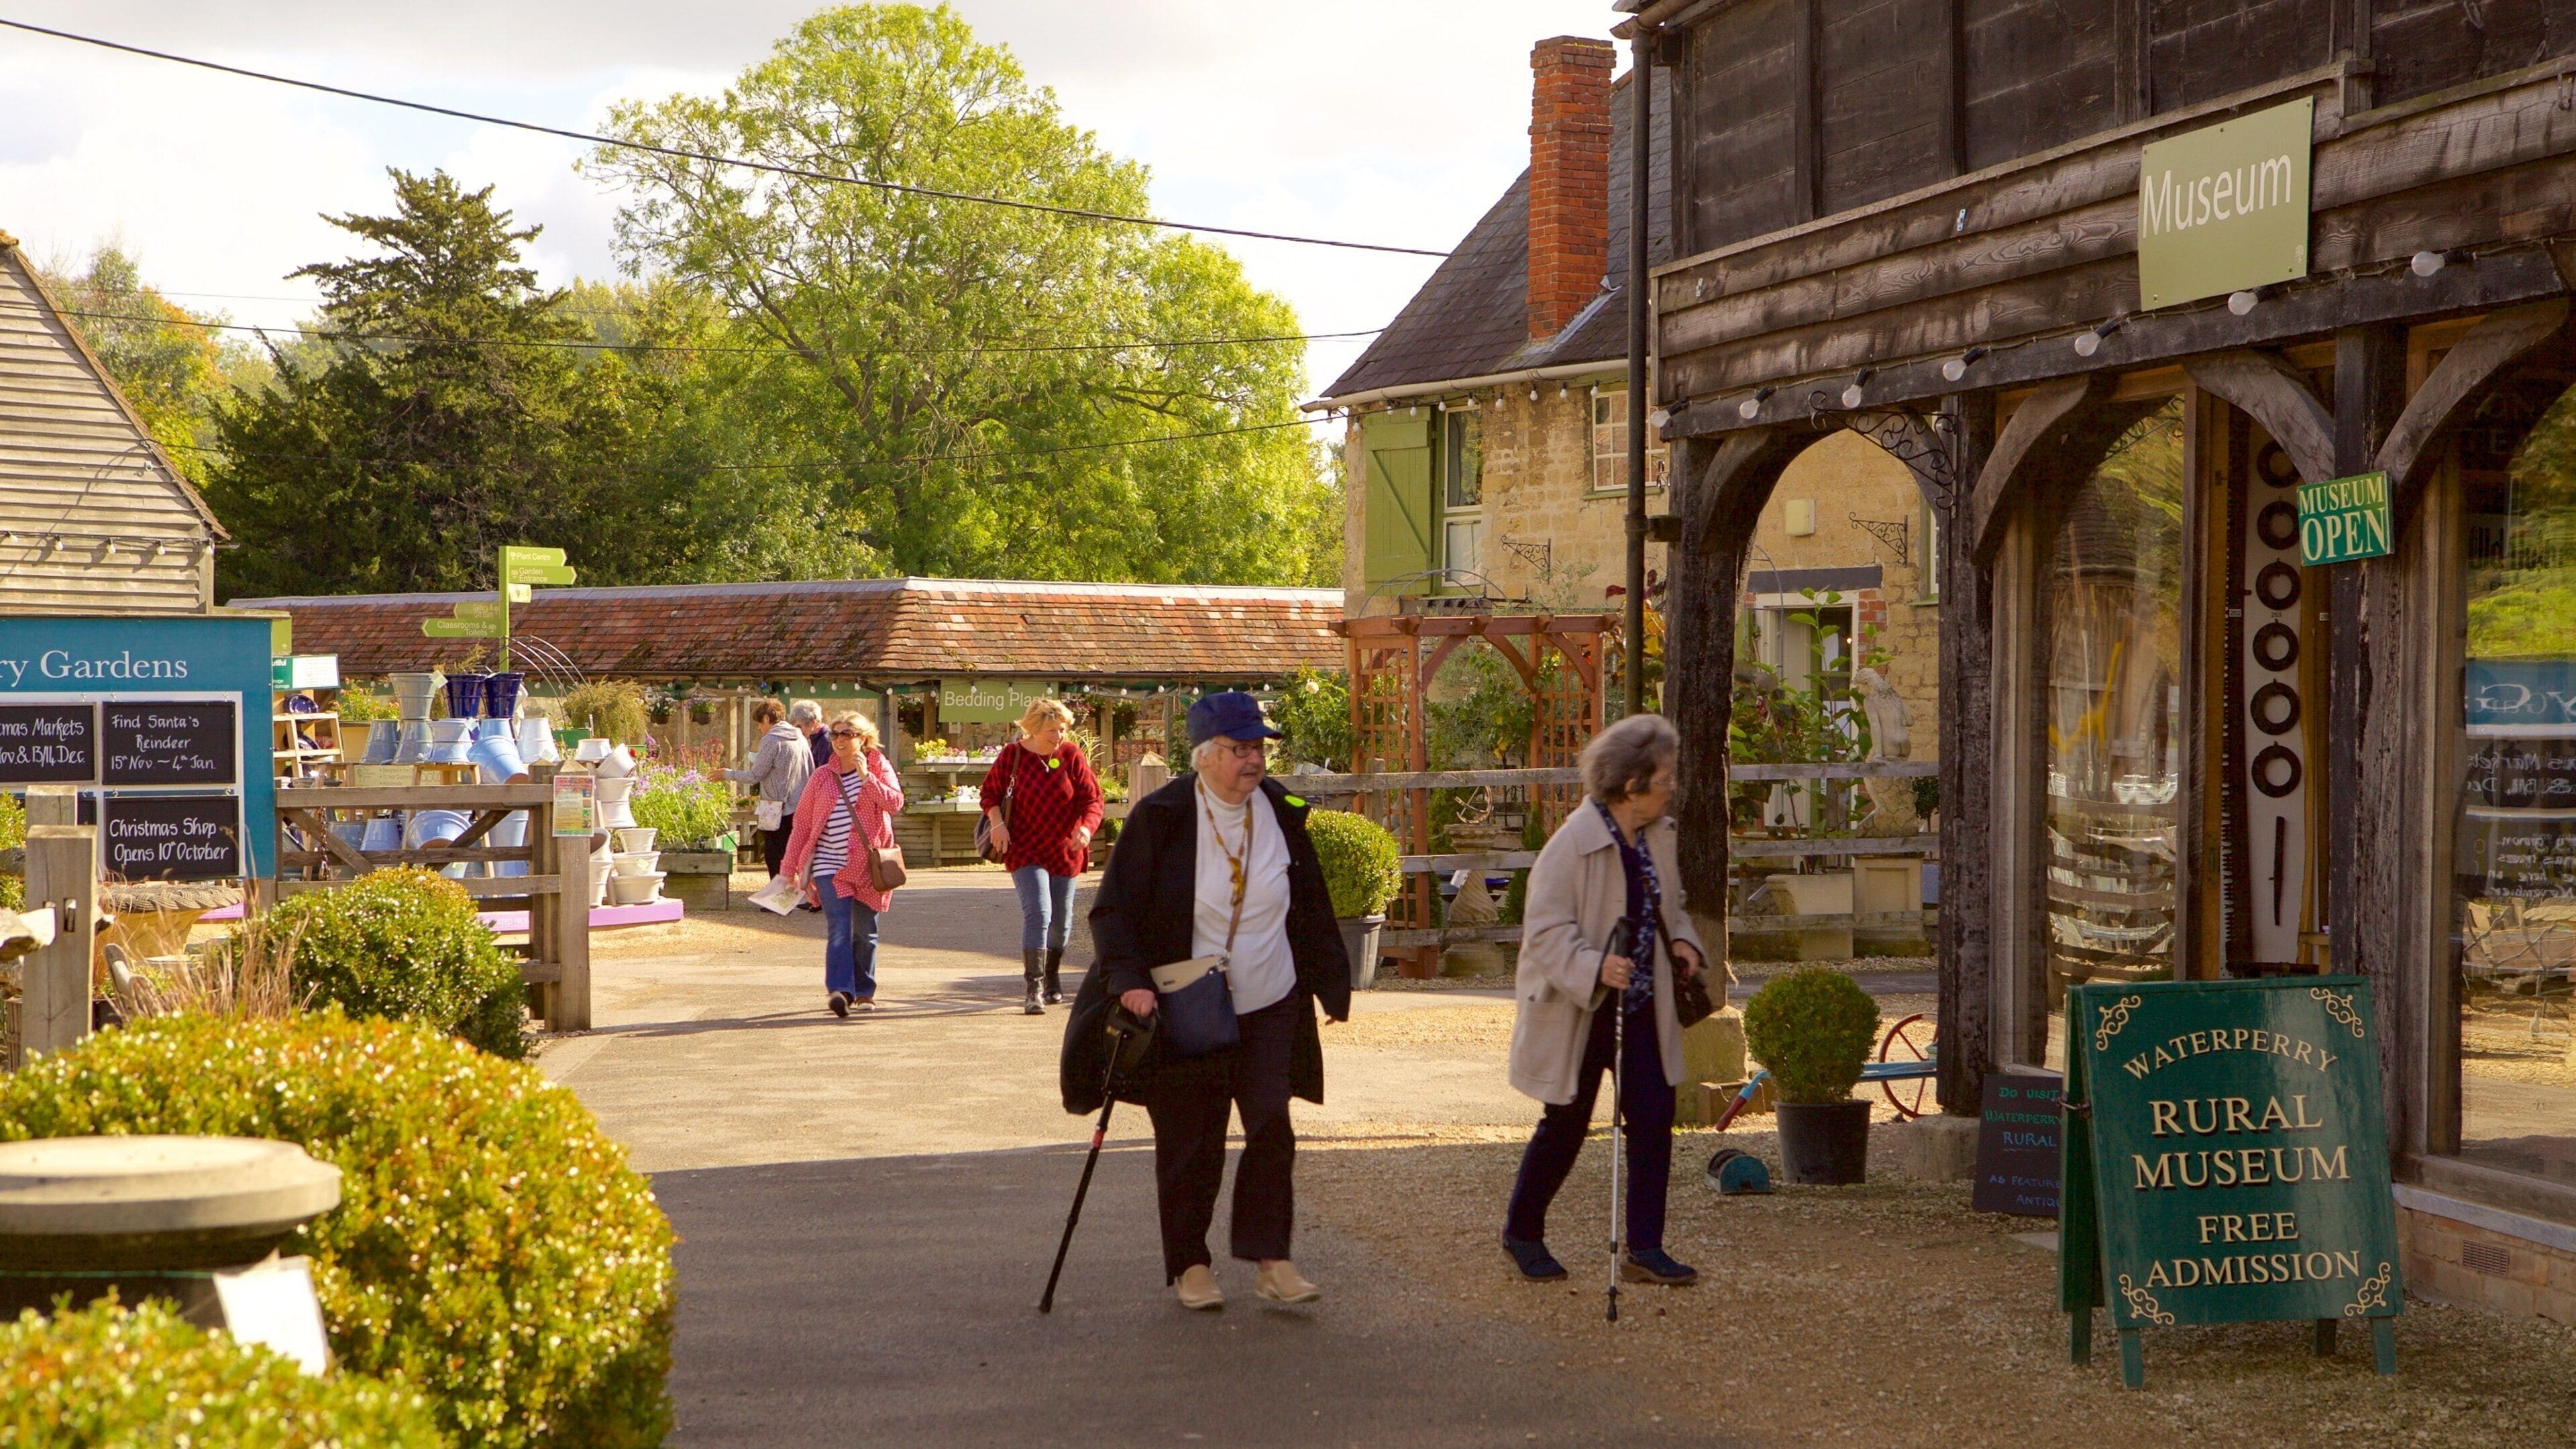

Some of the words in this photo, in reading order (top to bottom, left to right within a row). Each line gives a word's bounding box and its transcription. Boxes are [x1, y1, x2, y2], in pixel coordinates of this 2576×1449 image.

[2142, 154, 2292, 239] Museum
[2299, 476, 2385, 516] MUSEUM
[2302, 507, 2387, 561] OPEN
[519, 568, 543, 576] Garden
[519, 575, 547, 583] Entrance
[437, 621, 480, 629] Classrooms
[464, 628, 488, 637] Toilets
[40, 650, 188, 678] Gardens
[945, 691, 1004, 711] Bedding
[32, 717, 85, 742] Markets
[111, 714, 142, 729] Find
[148, 714, 200, 729] Santa's
[56, 745, 86, 763] Dec.
[136, 734, 192, 753] Reindeer
[109, 818, 178, 838] Christmas
[183, 817, 217, 839] Shop
[114, 843, 155, 865] Opens
[176, 842, 229, 861] October
[2123, 1028, 2339, 1080] WATERPERRY
[2026, 1089, 2059, 1101] VISIT
[2148, 1095, 2323, 1136] RURAL
[2002, 1132, 2057, 1147] RURAL
[2132, 1146, 2351, 1190] MUSEUM
[1988, 1175, 2006, 1184] AS
[2197, 1213, 2299, 1244] FREE
[2145, 1250, 2361, 1288] ADMISSION
